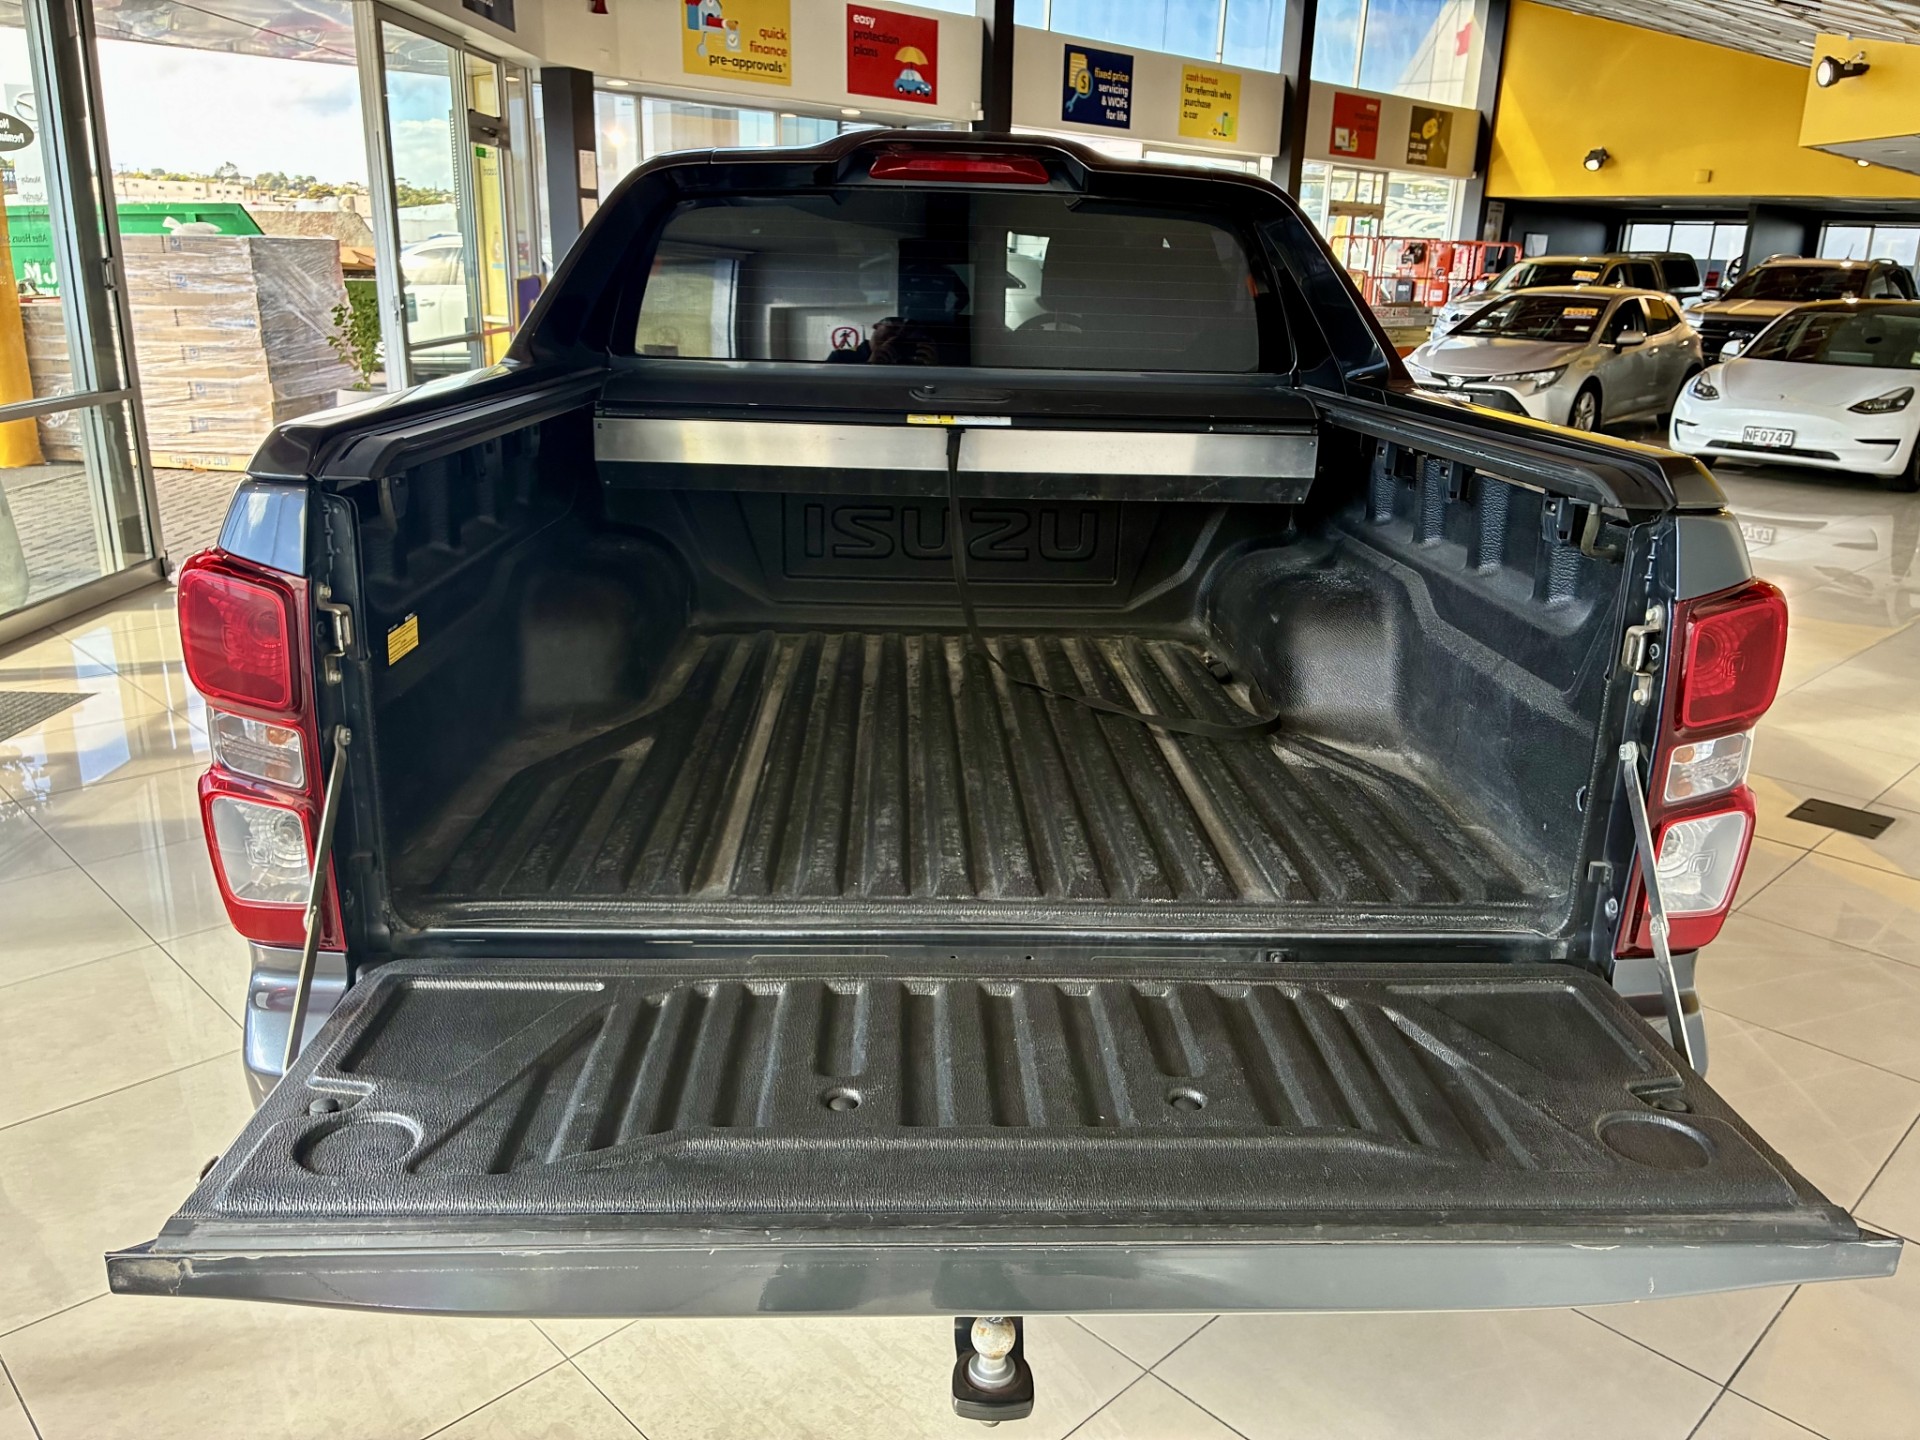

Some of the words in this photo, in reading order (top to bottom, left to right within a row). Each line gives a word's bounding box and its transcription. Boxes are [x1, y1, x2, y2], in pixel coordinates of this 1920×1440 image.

[852, 13, 876, 29] easy
[759, 26, 787, 41] quick
[852, 29, 900, 45] protection
[749, 41, 787, 58] finance
[853, 44, 879, 58] plans
[1094, 67, 1111, 80] fixed
[1112, 71, 1129, 84] price
[1186, 72, 1200, 82] cash
[1200, 75, 1218, 86] bonus
[1098, 83, 1129, 97] servicing
[1185, 84, 1194, 94] for
[1194, 86, 1218, 98] referrals
[1219, 89, 1232, 100] who
[1101, 95, 1107, 105] &
[1107, 96, 1128, 109] WOFs
[1184, 98, 1211, 110] purchase
[1106, 109, 1116, 120] for
[1117, 110, 1127, 122] life
[1744, 429, 1791, 445] NFQ747
[804, 503, 1099, 564] ISUZU
